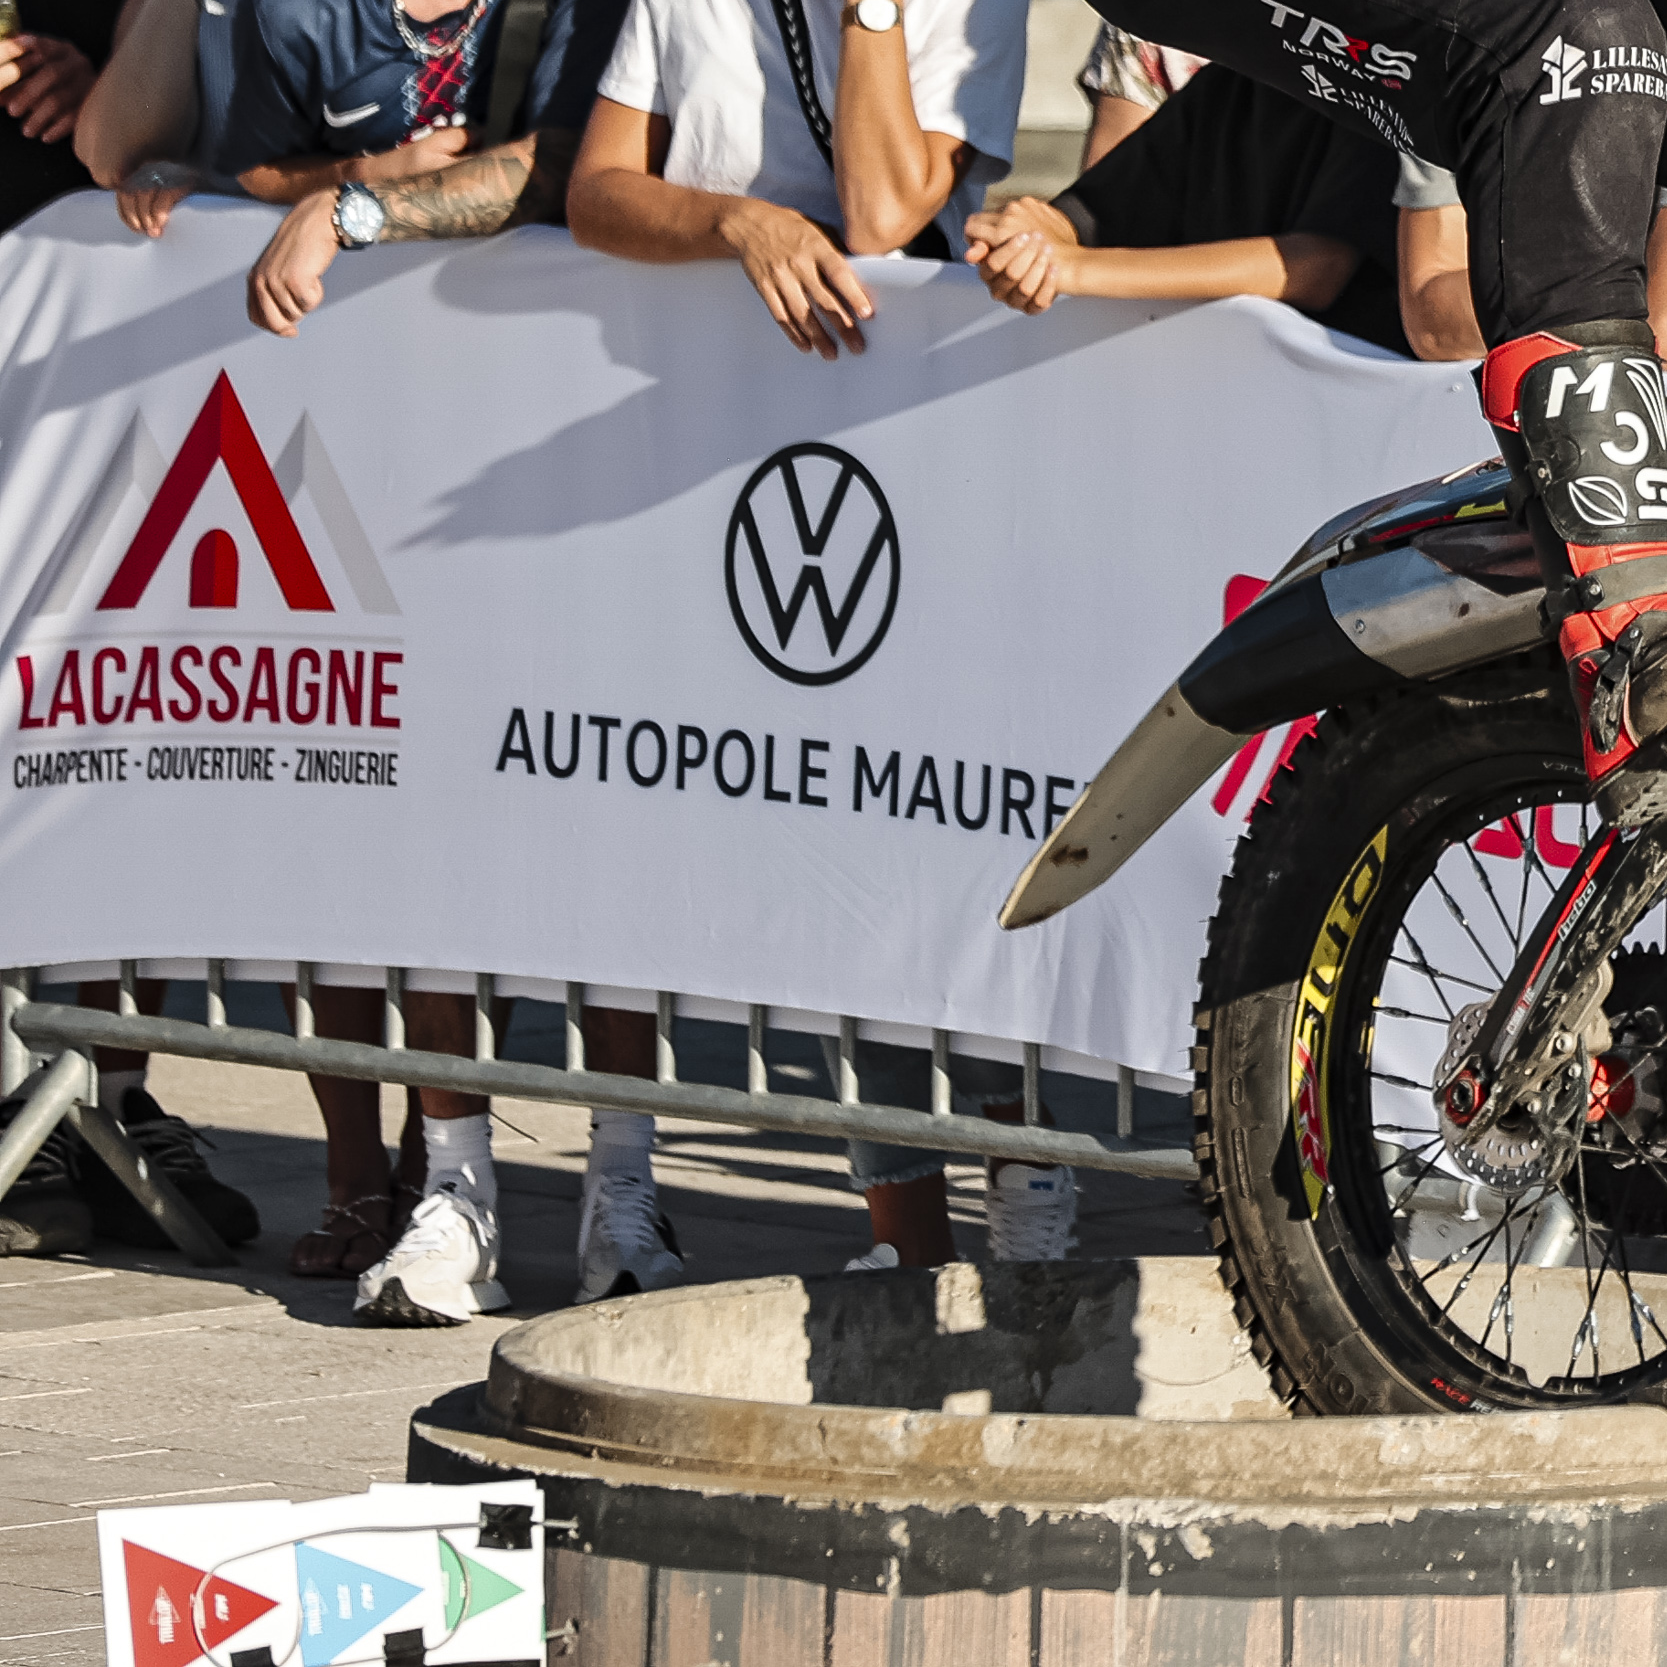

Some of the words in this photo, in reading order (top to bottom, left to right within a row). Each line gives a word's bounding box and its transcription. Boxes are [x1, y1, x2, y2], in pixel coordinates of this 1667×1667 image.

[16, 645, 404, 730] LACASSAGNE
[13, 748, 128, 789] CHARPENTE
[147, 746, 275, 781] COUVERTURE
[295, 748, 399, 787] ZINGUERIE
[496, 707, 830, 807] AUTOPOLE
[852, 745, 1094, 840] MAURE
[1558, 877, 1598, 942] hebo
